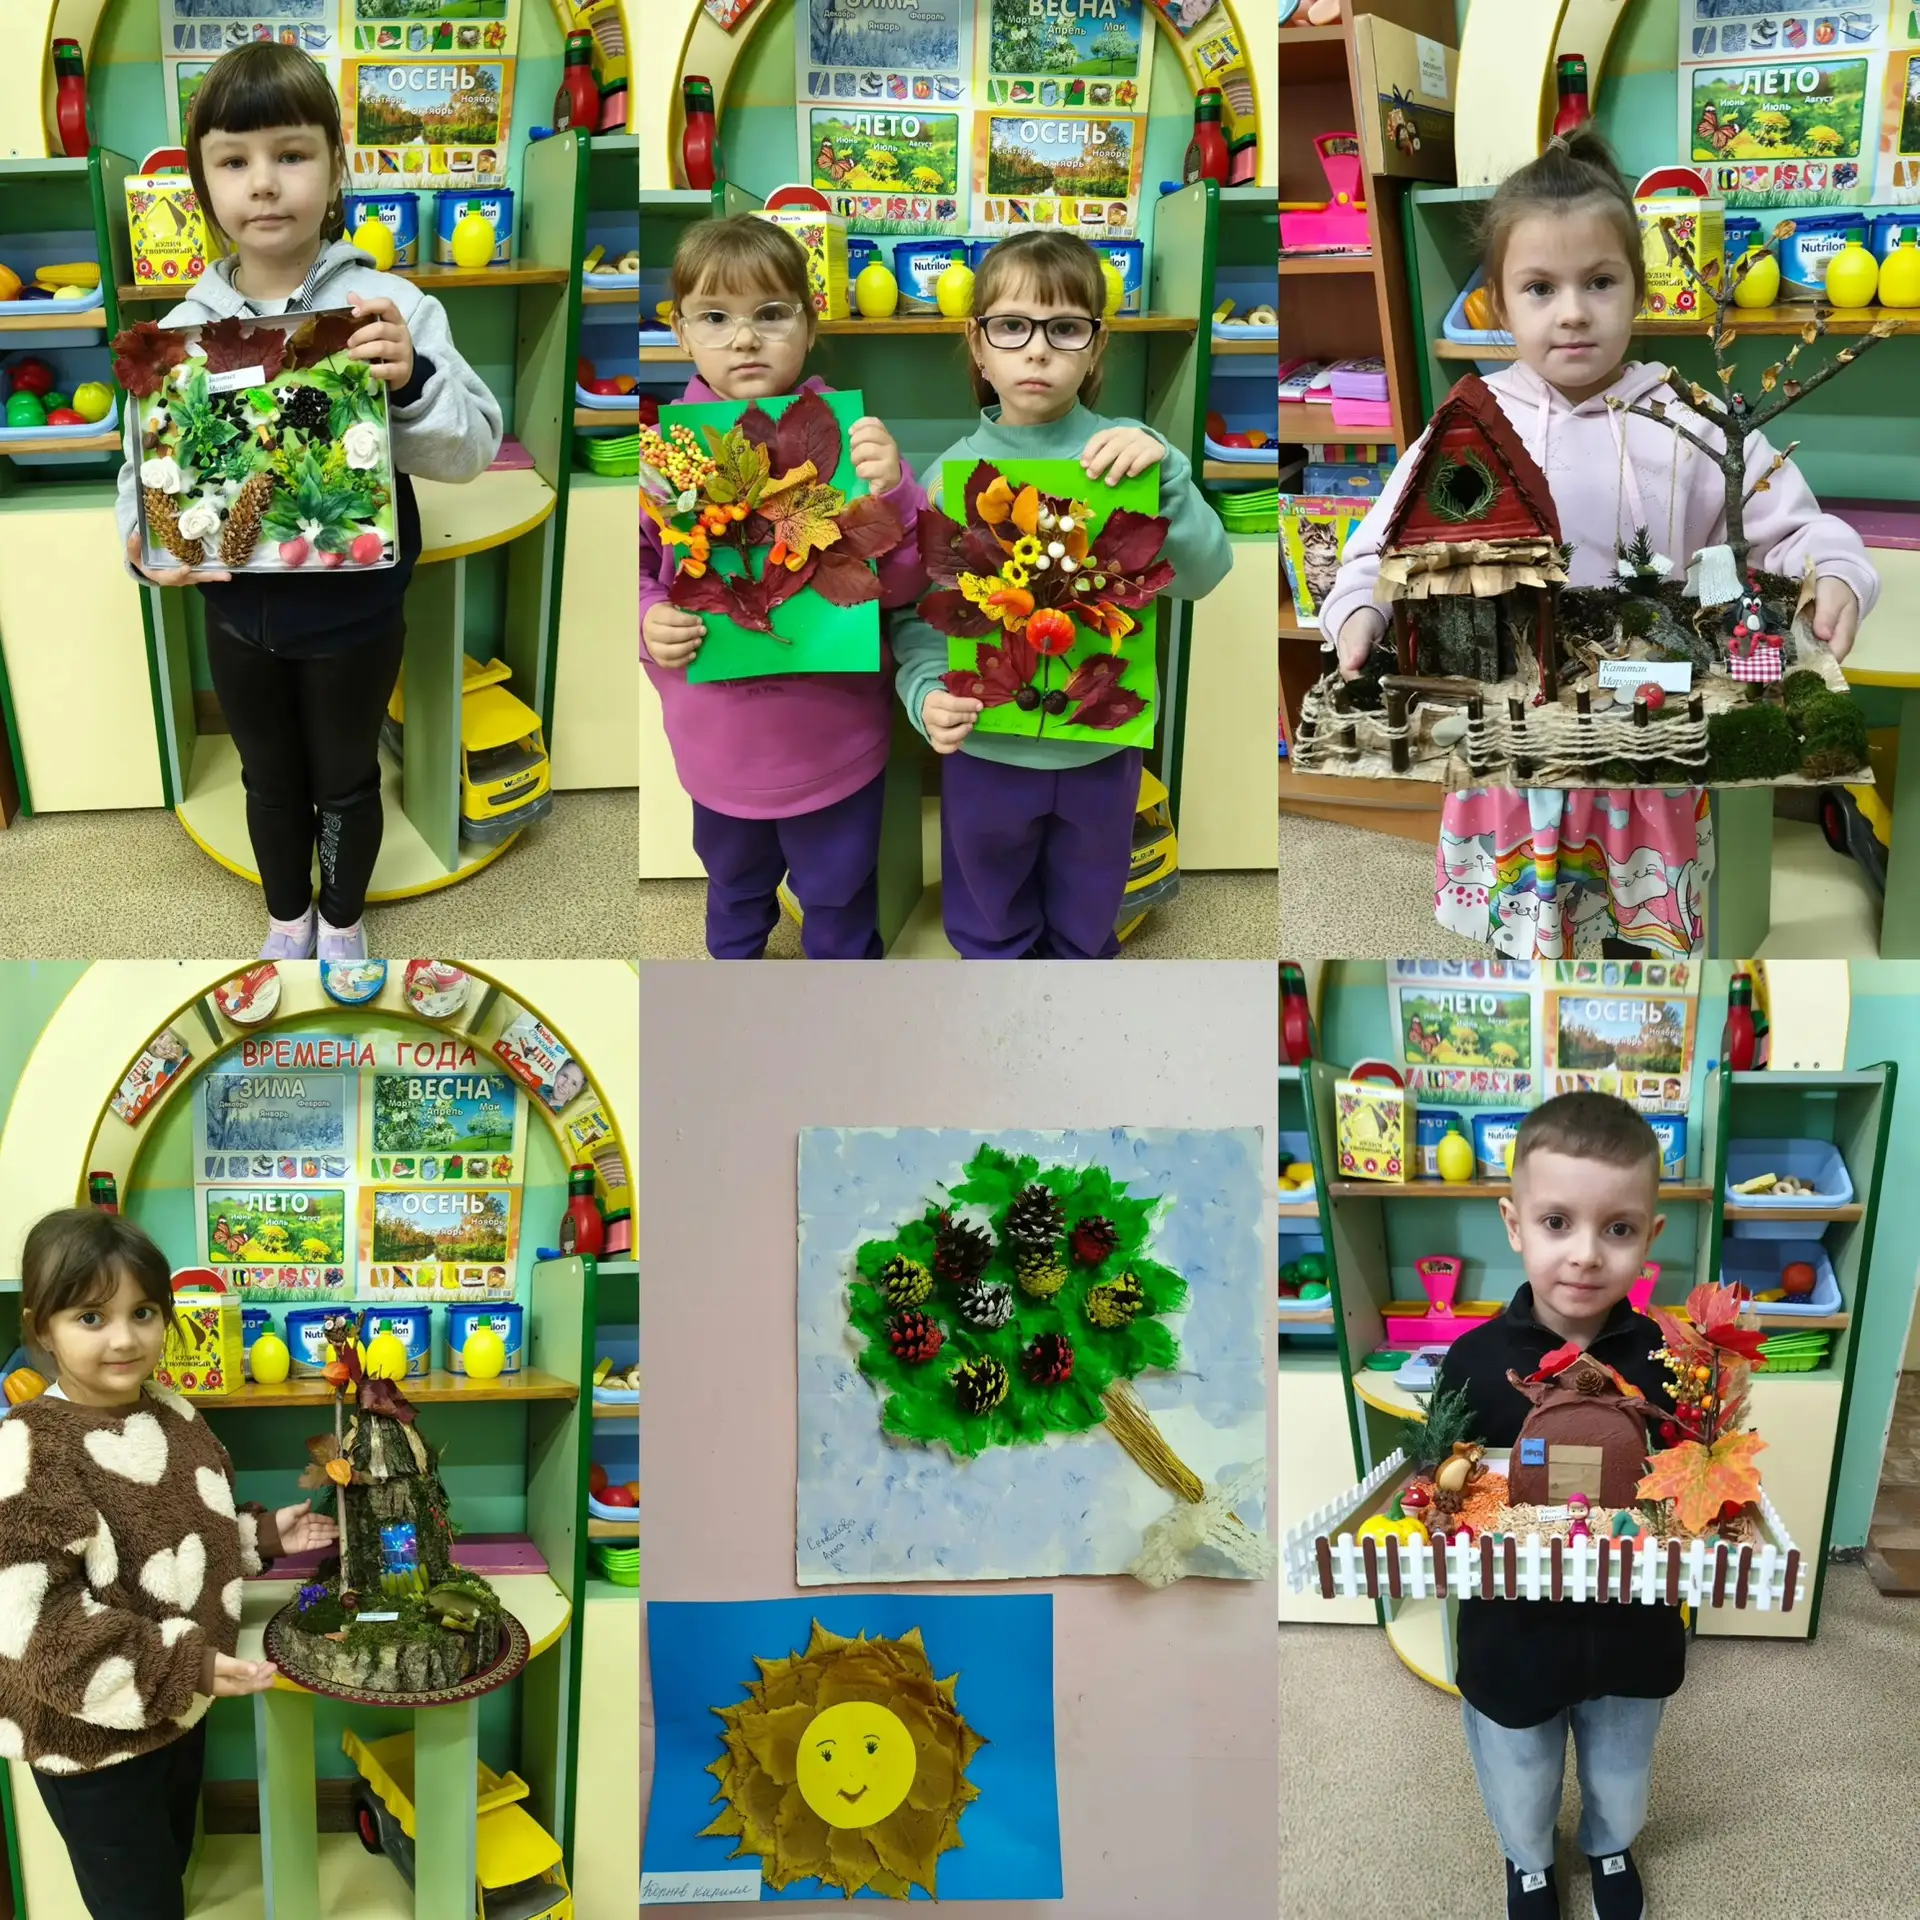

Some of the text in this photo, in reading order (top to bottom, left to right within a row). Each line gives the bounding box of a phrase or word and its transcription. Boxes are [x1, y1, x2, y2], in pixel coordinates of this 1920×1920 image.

[824, 10, 855, 19] Декабрь
[1029, 0, 1117, 19] ВЕСНА
[909, 11, 945, 22] Февраль
[868, 21, 900, 33] Январь
[1048, 25, 1087, 36] Апрель
[388, 67, 476, 91] ОСЕНЬ
[1740, 66, 1820, 96] ЛЕТО
[1720, 99, 1746, 107] Июнь
[1804, 95, 1834, 104] Август
[1762, 103, 1791, 112] Июль
[854, 114, 920, 138] ЛЕТО
[1020, 121, 1107, 145] ОСЕНЬ
[873, 143, 899, 152] Июль
[909, 140, 934, 148] Август
[359, 212, 396, 223] Nilon
[1801, 243, 1846, 253] Nutrilon
[399, 248, 407, 262] 2
[914, 261, 951, 271] Nutrilon
[1602, 662, 1648, 673] Капитан
[1439, 993, 1497, 1016] ЛЕТО
[1585, 1000, 1663, 1024] ОСЕНЬ
[242, 1040, 477, 1071] ВРЕМЕНА ГОДА
[240, 1078, 306, 1098] ЗИМА
[408, 1078, 491, 1100] ВЕСНА
[260, 1109, 289, 1120] Январь
[427, 1107, 463, 1117] Апрель
[247, 1192, 309, 1213] ЛЕТО
[402, 1193, 485, 1214] ОСЕНЬ
[411, 1359, 418, 1372] 2
